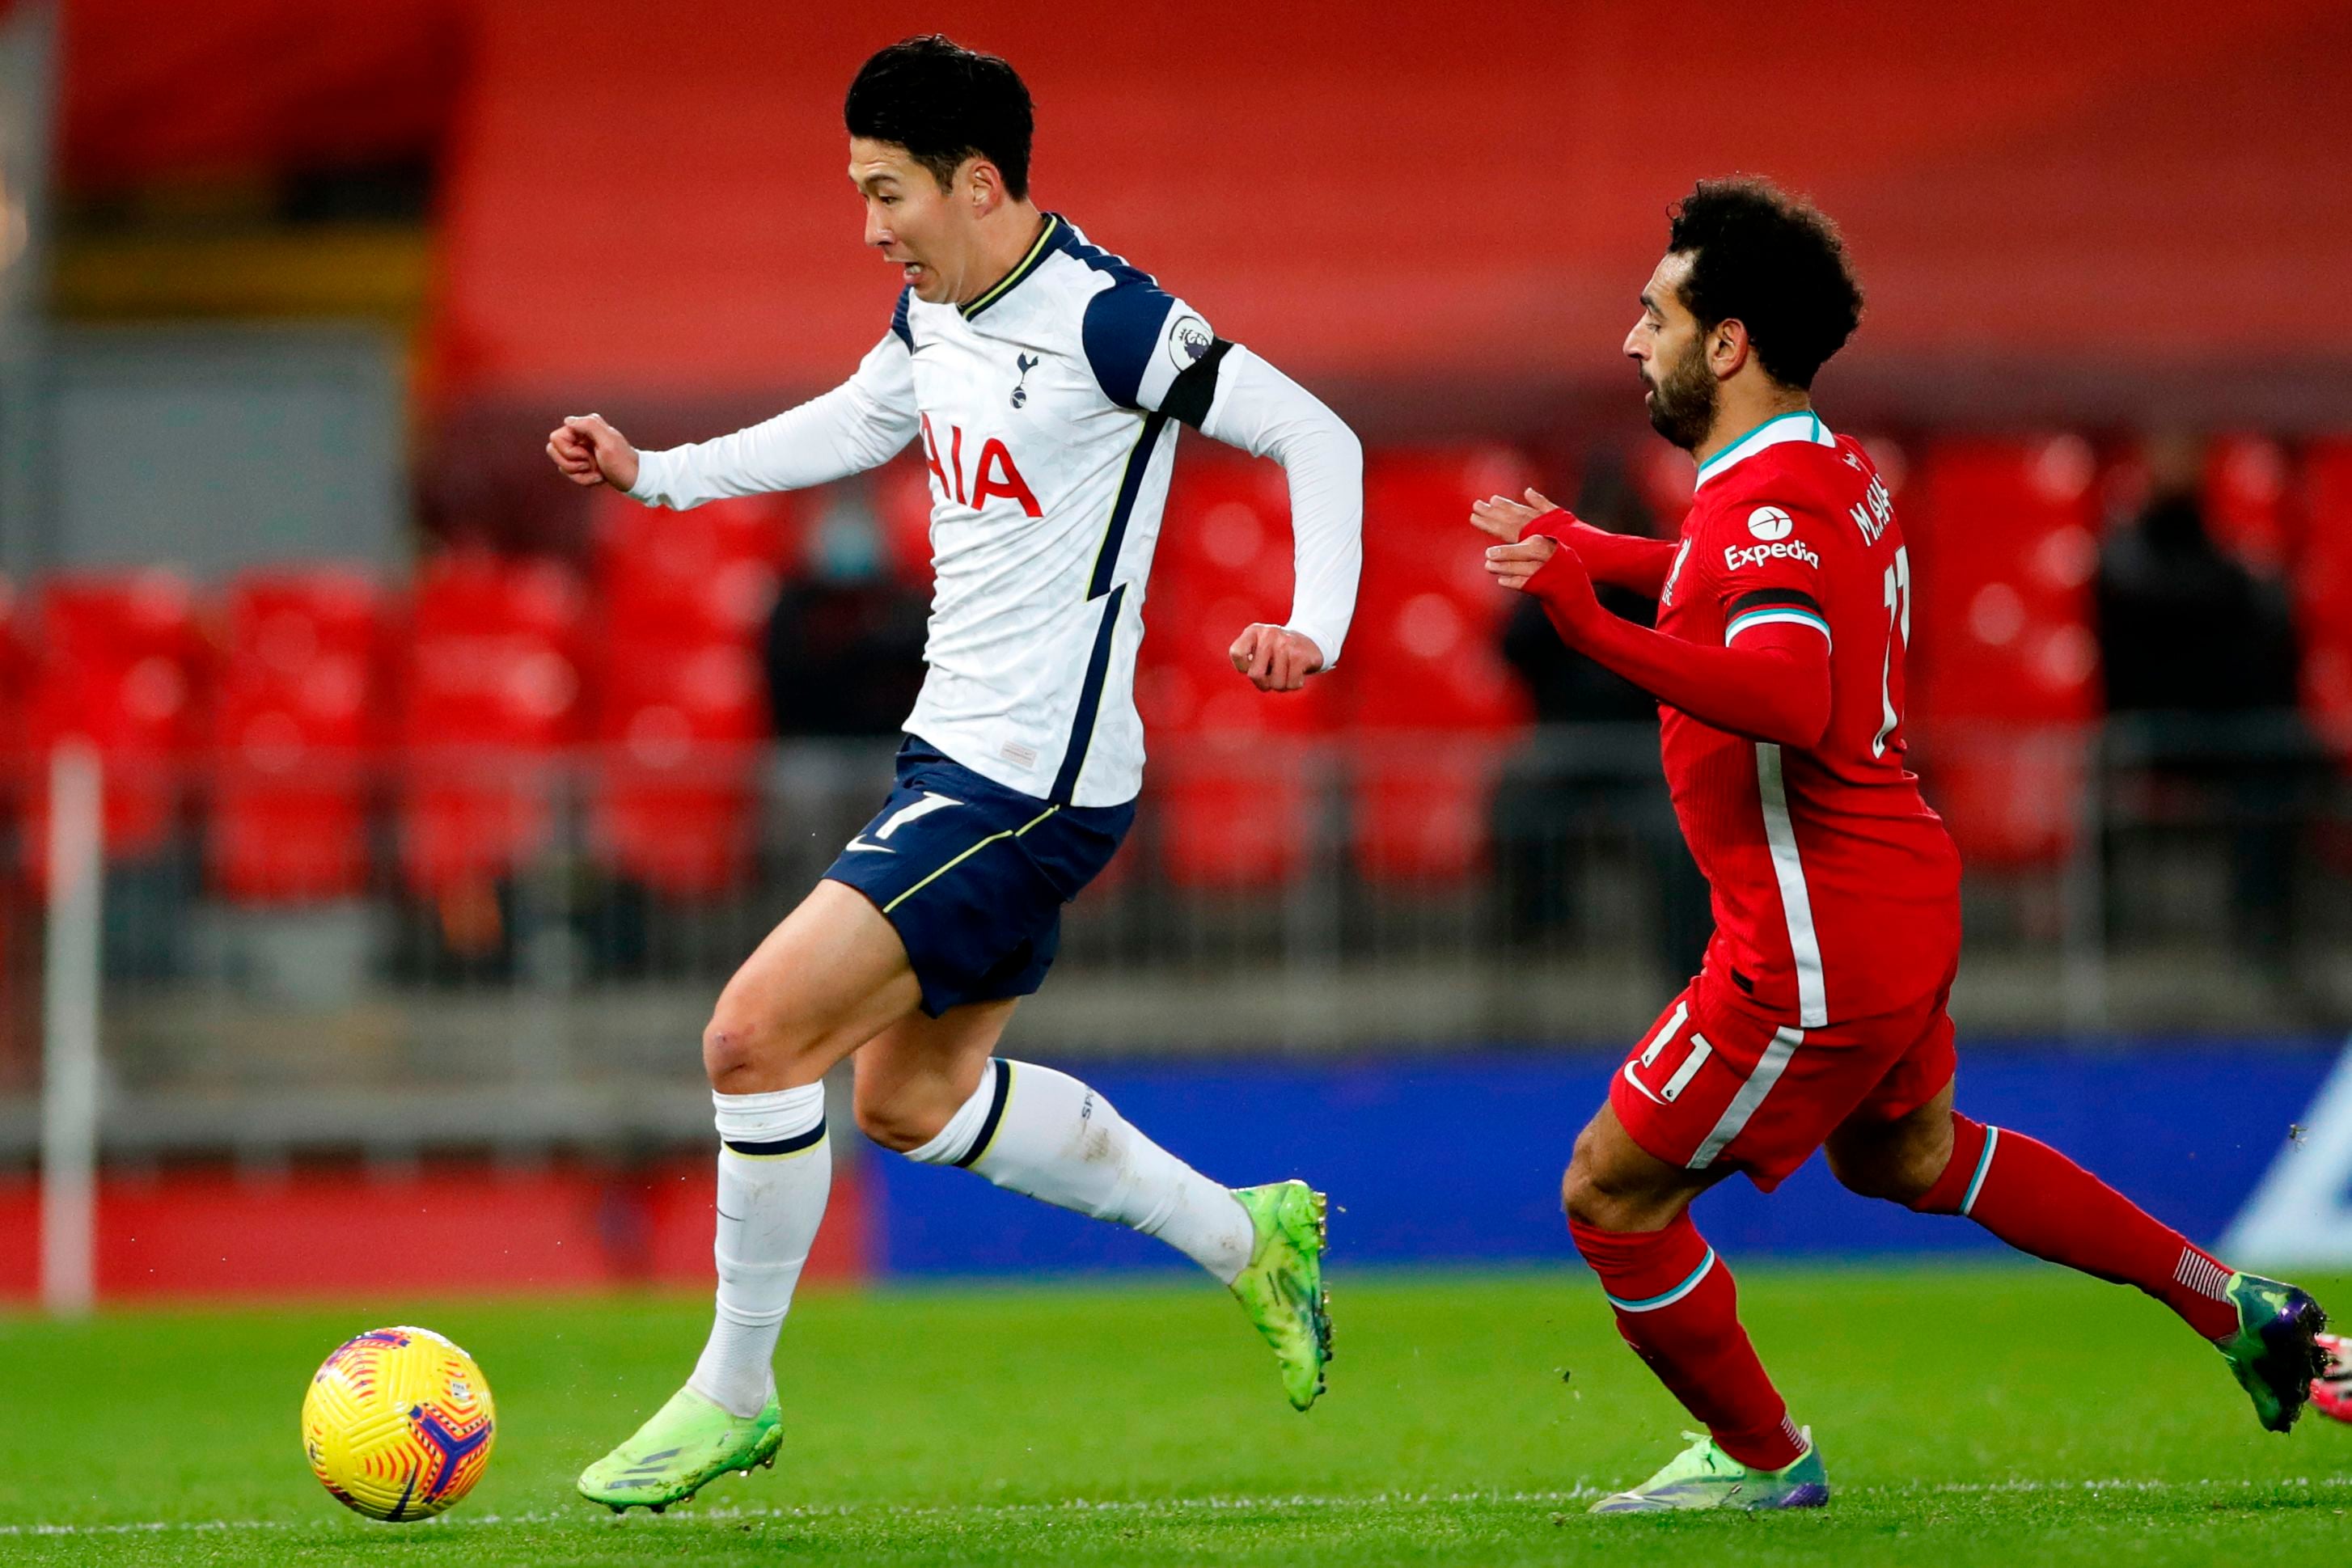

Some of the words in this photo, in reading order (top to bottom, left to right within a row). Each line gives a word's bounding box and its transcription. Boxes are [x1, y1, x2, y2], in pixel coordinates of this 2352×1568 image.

[920, 411, 1044, 518] AIA
[1724, 539, 1819, 571] Expedia
[1872, 544, 1910, 759] 11
[875, 791, 965, 840] 7
[1640, 1000, 1713, 1103] 11
